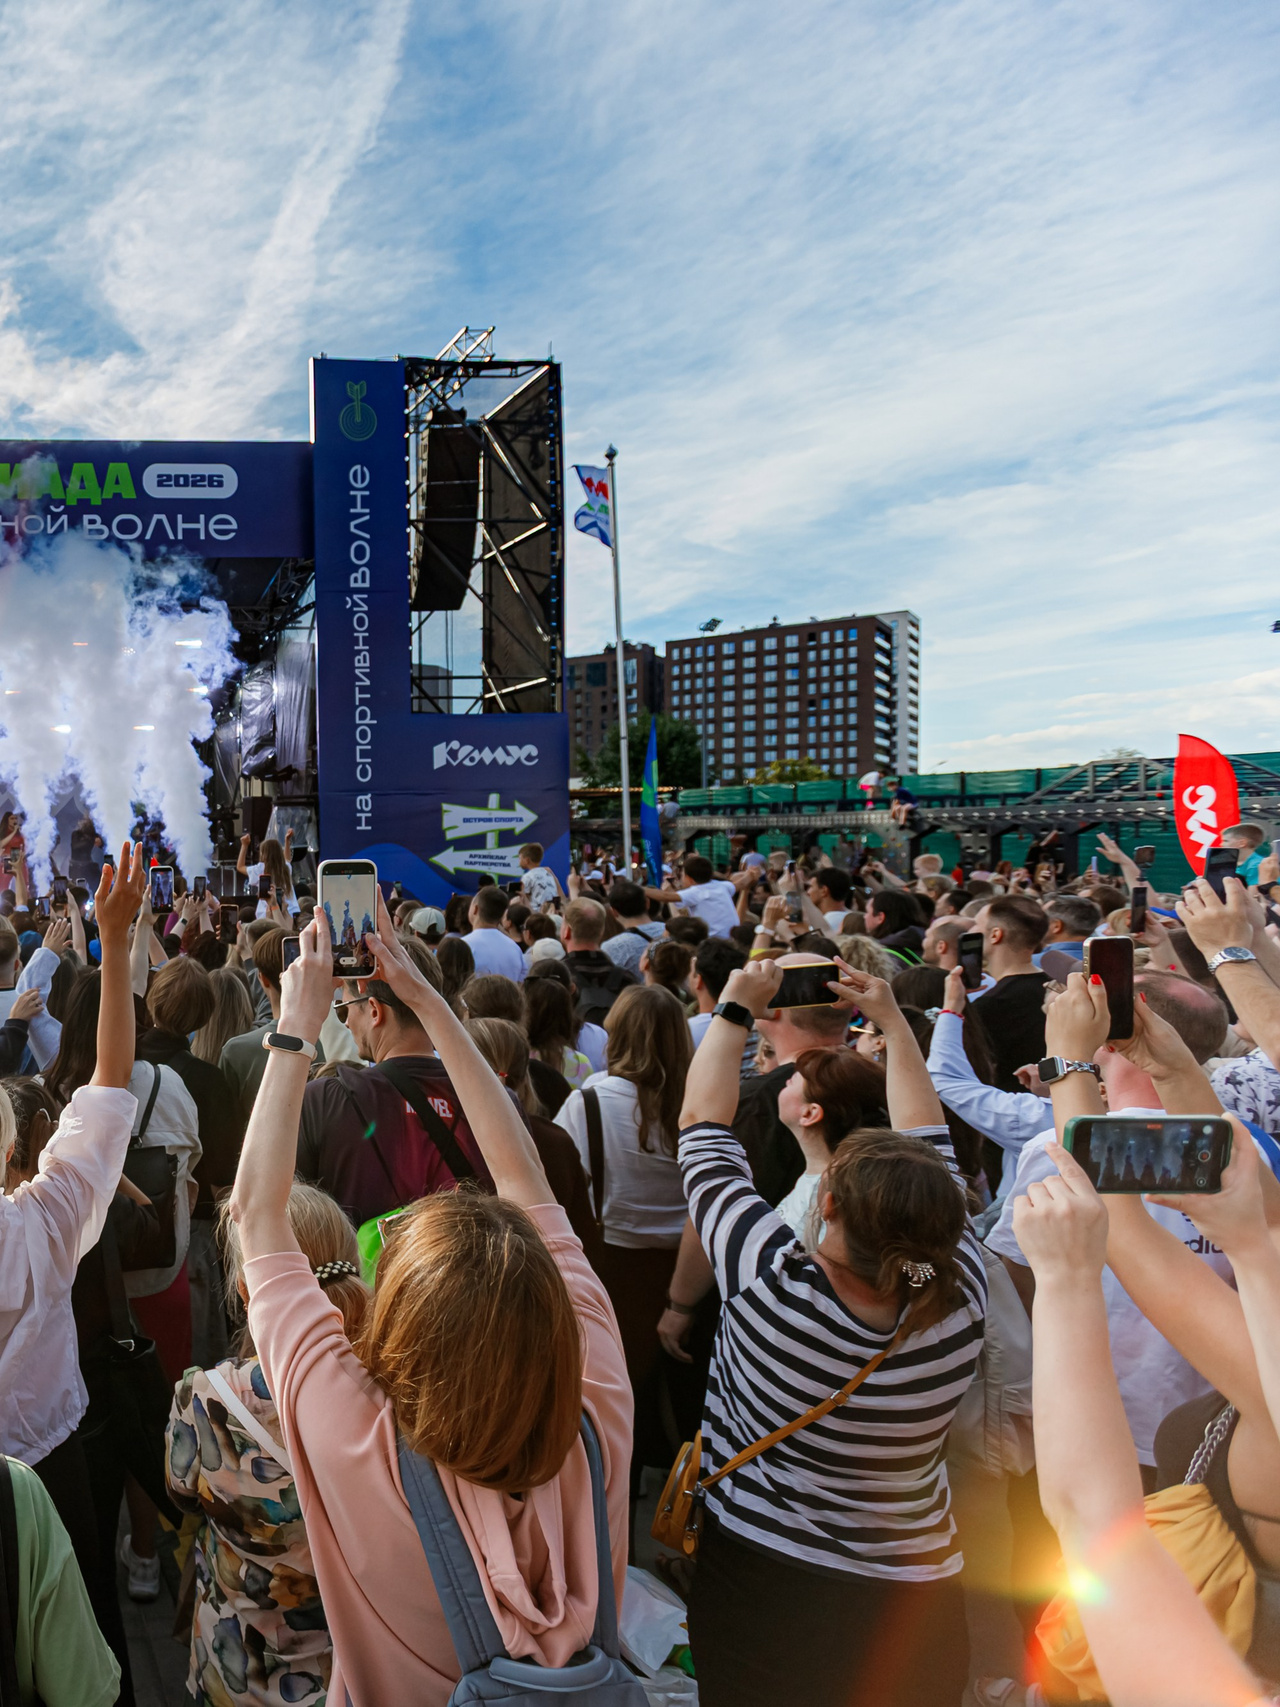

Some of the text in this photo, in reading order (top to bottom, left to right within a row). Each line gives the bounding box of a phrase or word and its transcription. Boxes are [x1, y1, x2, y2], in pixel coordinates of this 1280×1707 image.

[156, 473, 225, 488] 2026
[346, 594, 378, 782] спортивной
[356, 793, 372, 830] на
[462, 816, 524, 824] ОСТРОВ СПОРТА
[464, 860, 511, 868] ПАРТНЕРСТВА
